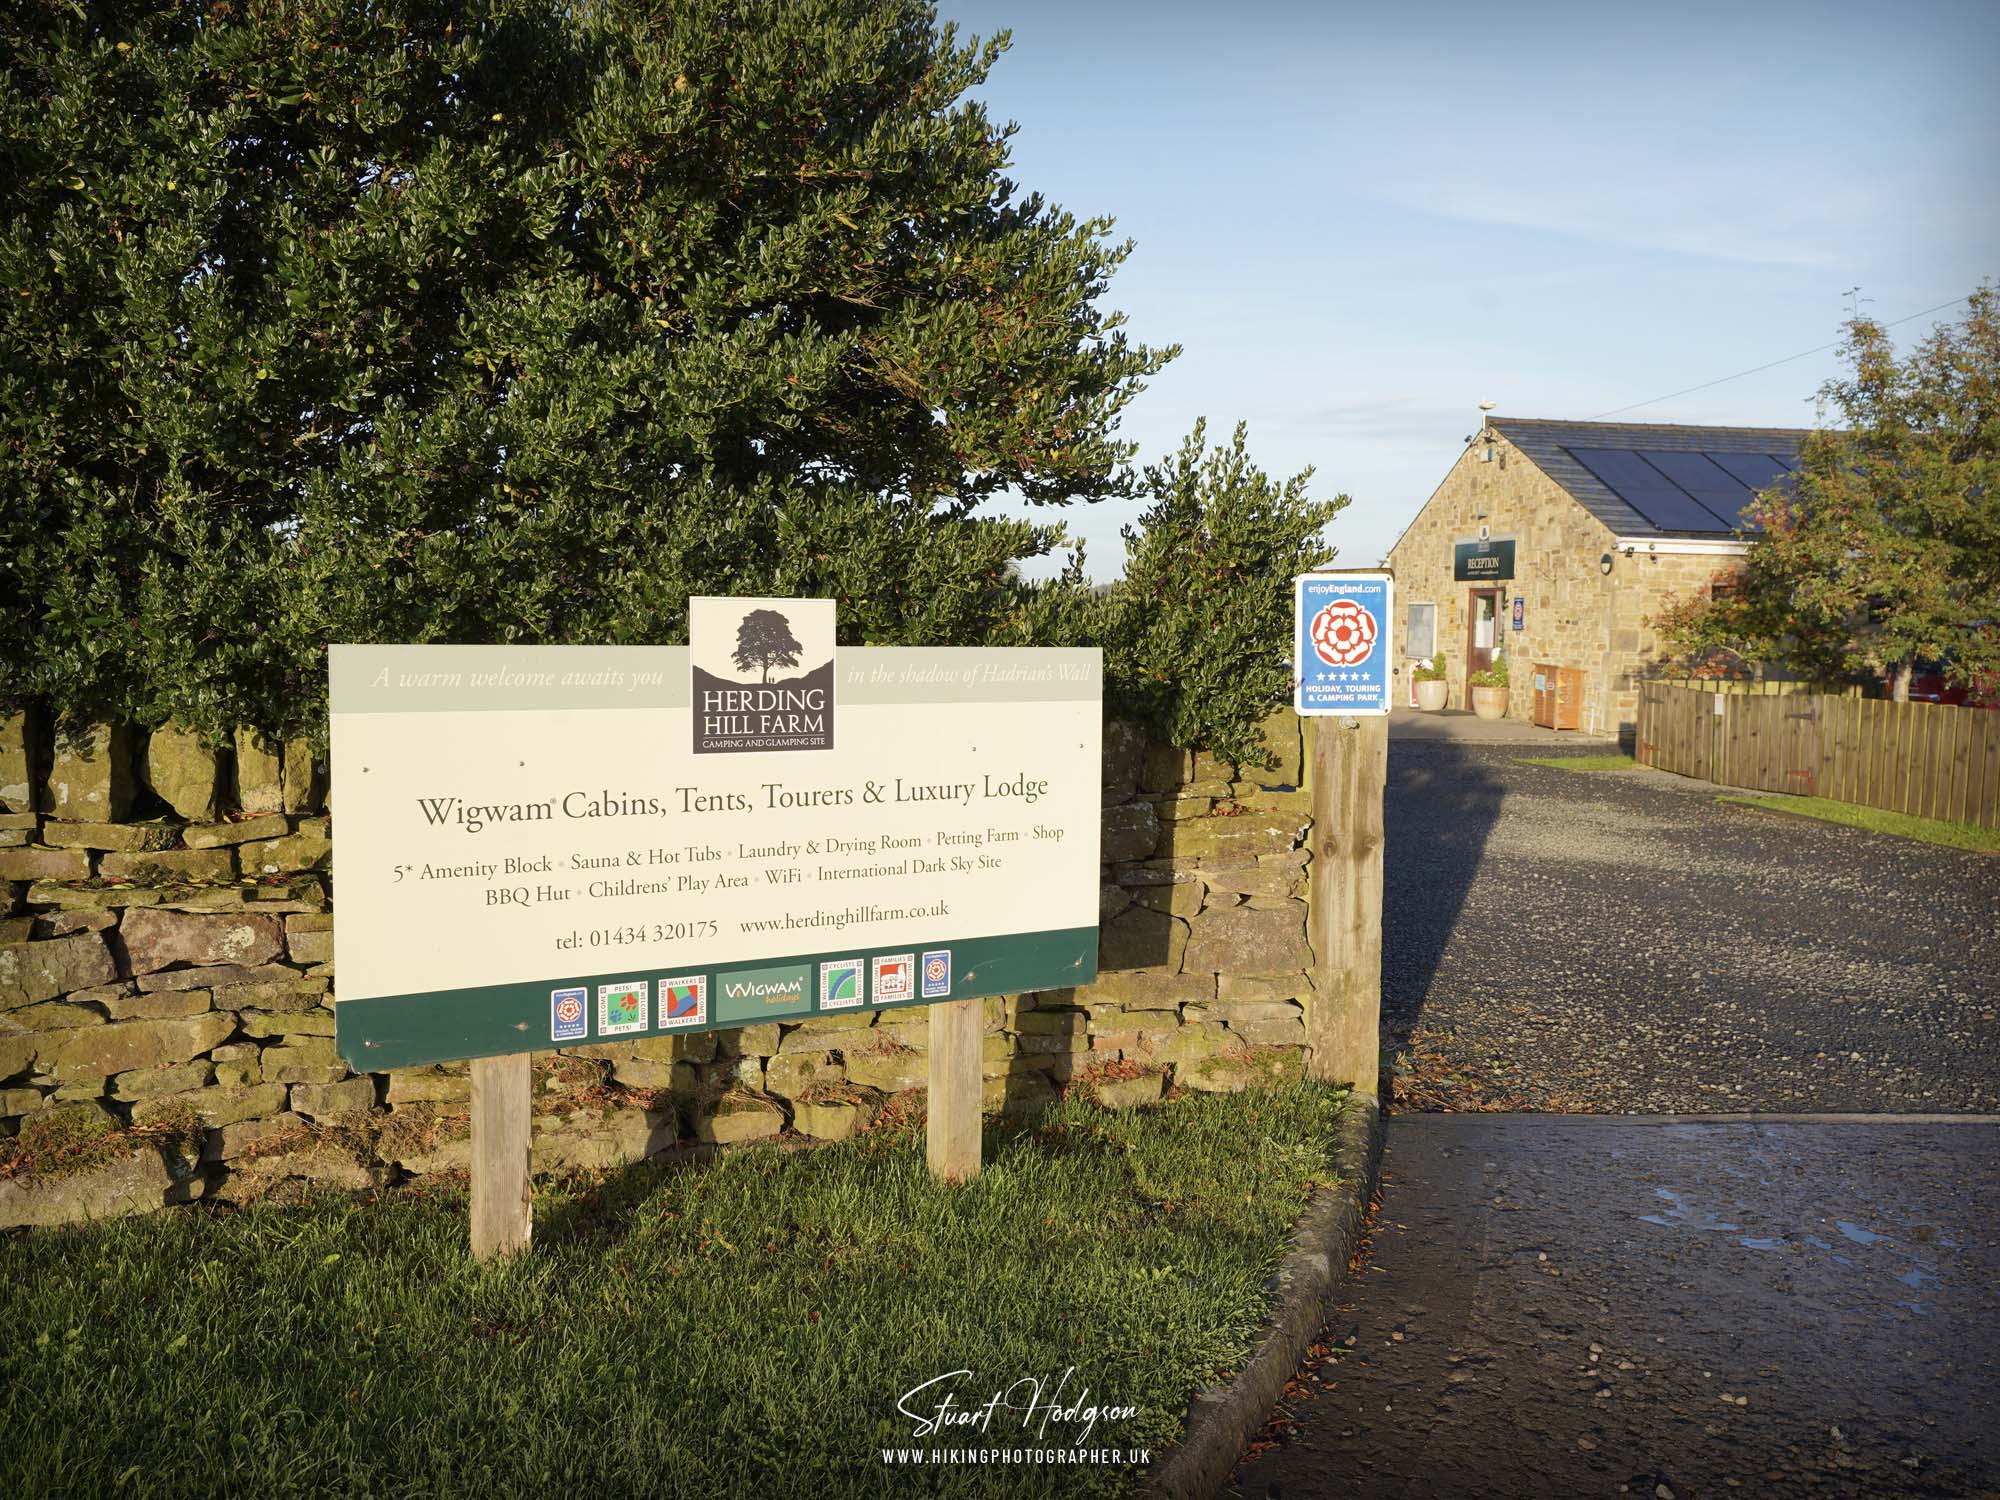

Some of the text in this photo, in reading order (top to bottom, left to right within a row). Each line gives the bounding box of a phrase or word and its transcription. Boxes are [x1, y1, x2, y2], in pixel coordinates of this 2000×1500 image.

[1467, 557, 1499, 569] RECEPTION
[1308, 584, 1381, 595] enjoyEngland.com
[369, 665, 664, 692] A warm welcome awaits you
[848, 666, 864, 683] in
[872, 664, 895, 683] the
[899, 664, 958, 682] shadow
[962, 664, 982, 688] of
[1057, 663, 1091, 681] Wall
[1306, 685, 1381, 693] HOLIDAY, TOURING
[703, 689, 827, 713] HERDING
[703, 714, 825, 735] HILL FARM
[702, 737, 826, 749] CAMPING AND GLAMPING SITE
[562, 789, 667, 818] Cabins,
[675, 787, 753, 814] Tents,
[761, 783, 853, 809] Tourers
[862, 780, 886, 804] &
[895, 778, 976, 806] Luxury
[983, 772, 1049, 804] Lodge
[419, 861, 498, 881] Amenity
[504, 856, 553, 875] Block
[571, 853, 621, 870] Sauna
[626, 850, 642, 866] &
[649, 849, 680, 865] Hot
[684, 846, 722, 863] Tubs
[738, 841, 801, 859] Laundry
[806, 840, 821, 854] &
[826, 837, 876, 856] Drying
[881, 834, 922, 849] Room
[936, 831, 983, 847] Petting
[987, 828, 1019, 843] Farm
[1032, 824, 1064, 843] Shop
[486, 887, 533, 908] BBQ
[536, 885, 572, 902] Hut
[678, 874, 710, 894] Play
[714, 873, 748, 889] Area
[765, 867, 802, 885] WiFi
[818, 860, 907, 881] International
[912, 857, 946, 874] Dark
[950, 855, 974, 874] Sky
[977, 854, 1002, 869] Site
[556, 899, 949, 950] tel: 01434 320175 www.herdinghillfarm.co.uk
[829, 961, 855, 969] CYCLISTS
[881, 956, 906, 964] FAMILIES
[668, 978, 697, 986] WALKERS
[881, 993, 906, 1001] FAMILIES
[668, 1017, 697, 1026] WALKERS
